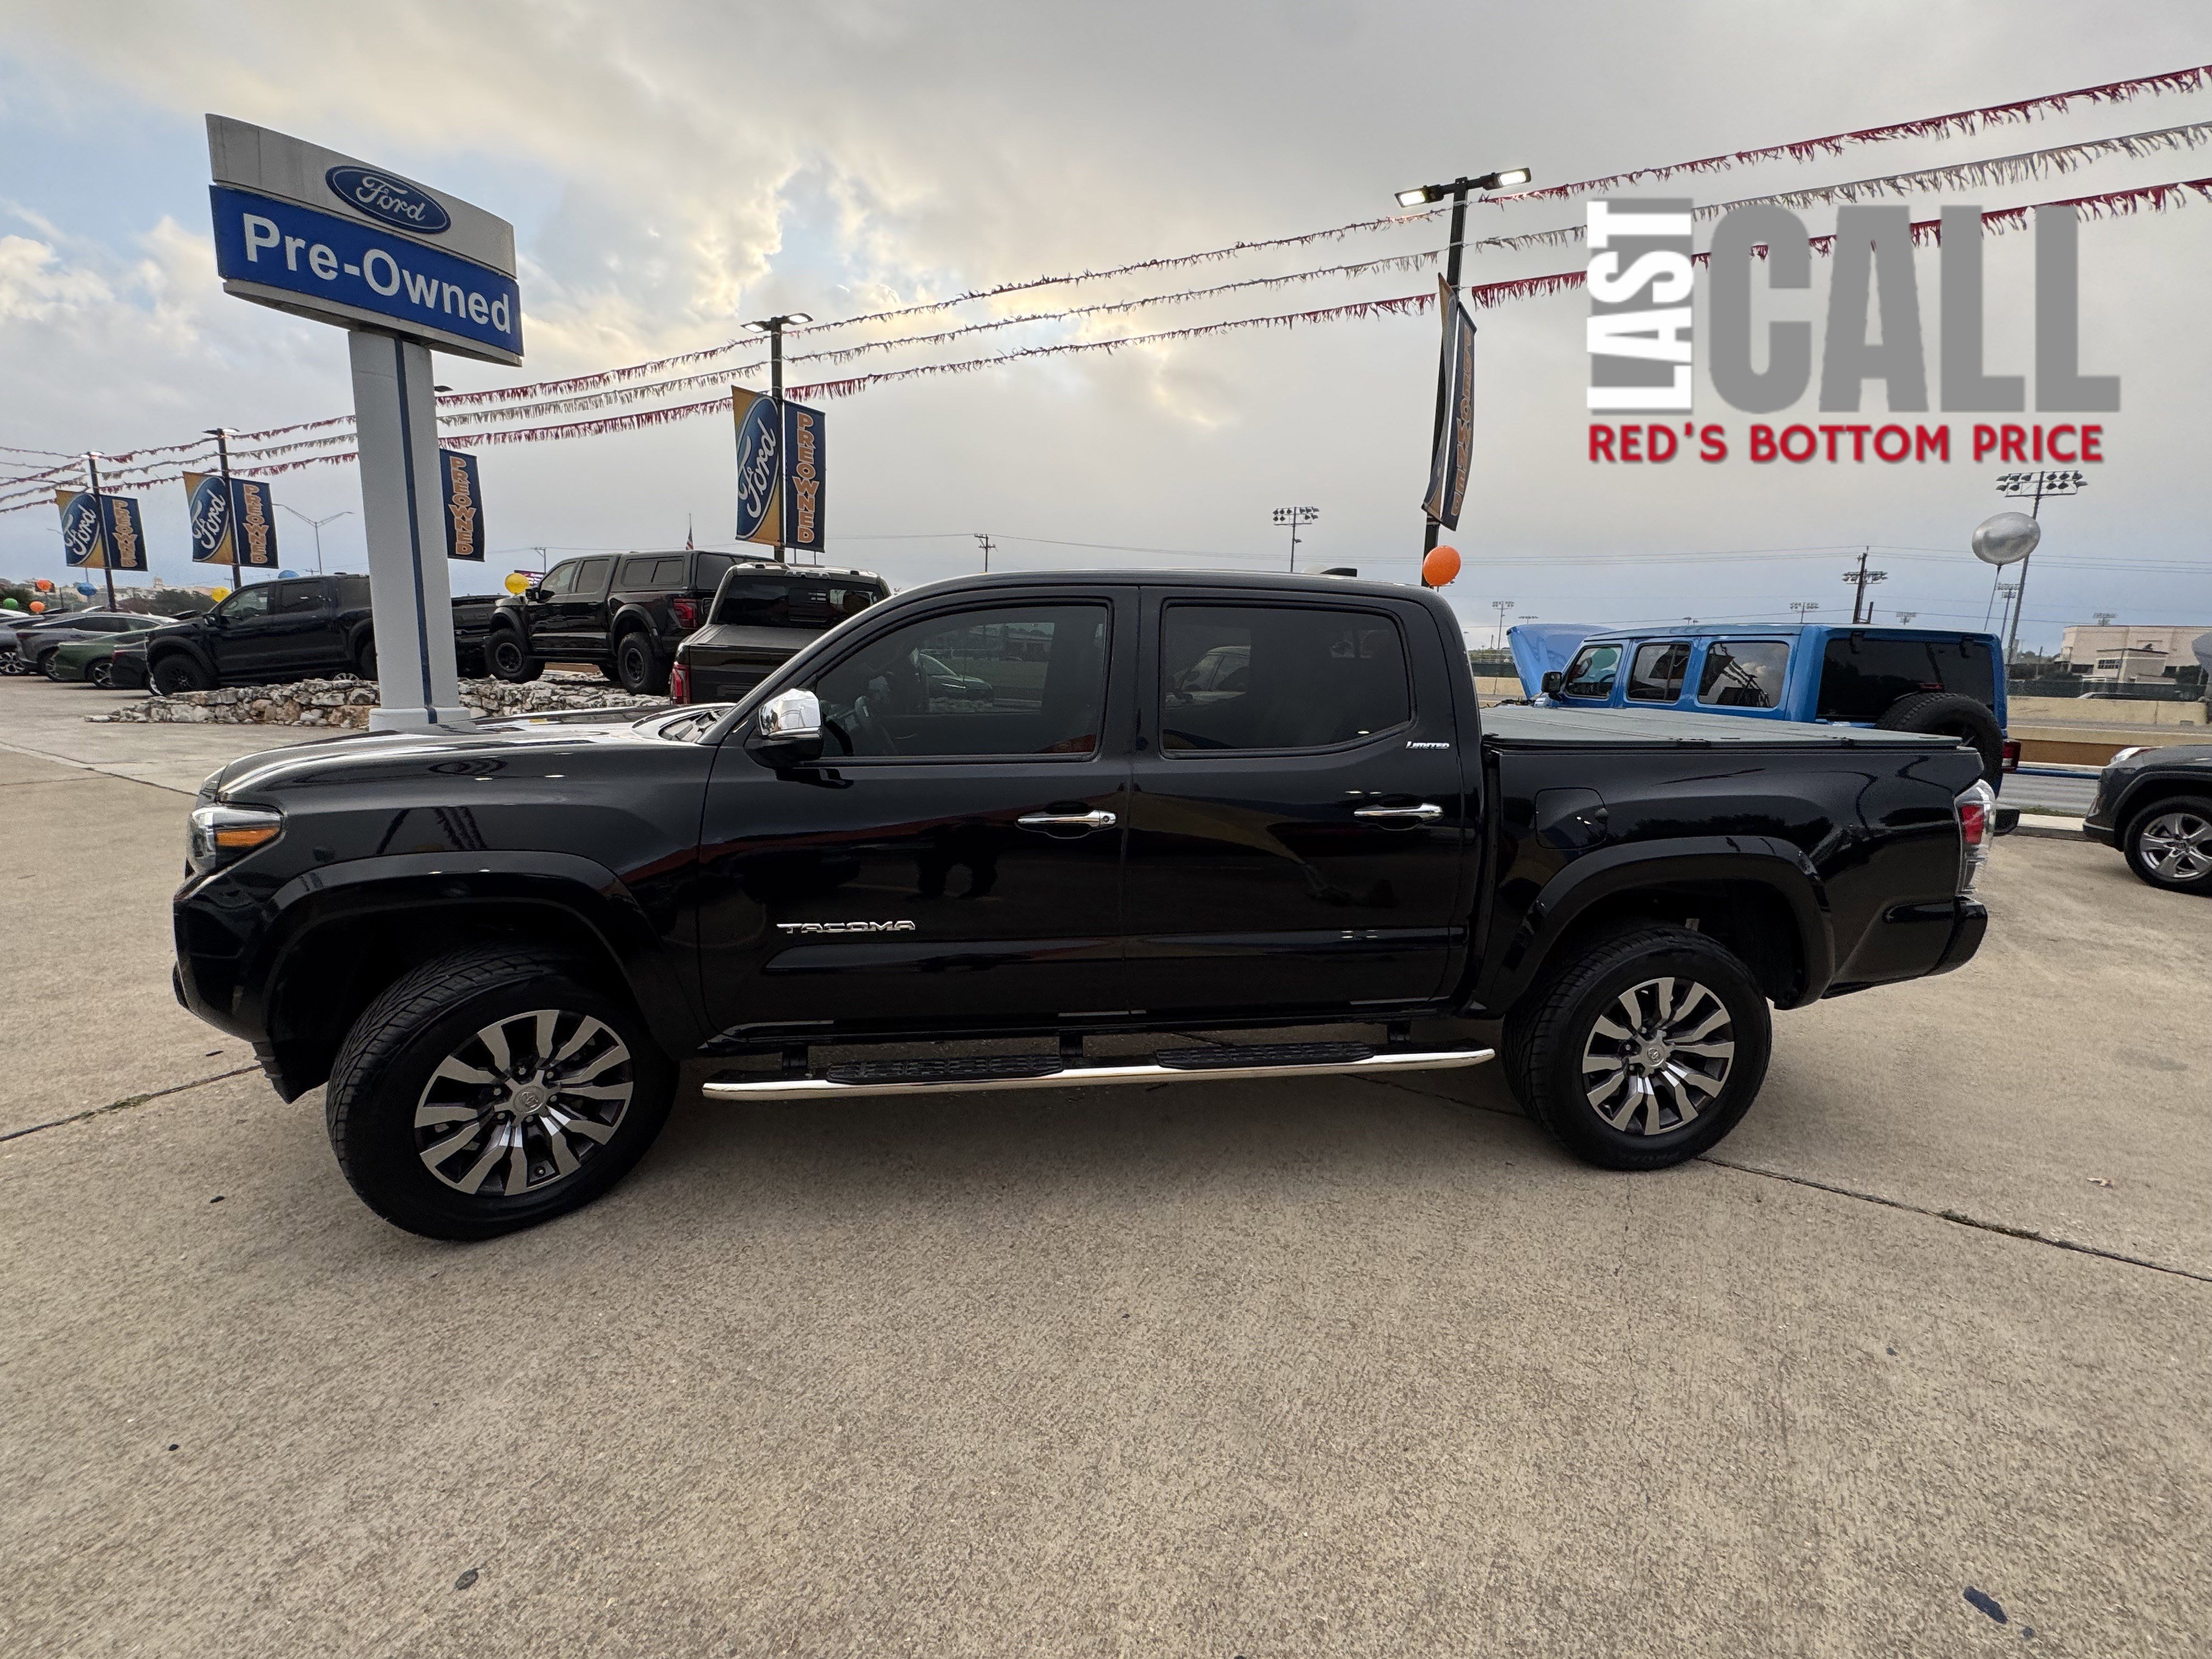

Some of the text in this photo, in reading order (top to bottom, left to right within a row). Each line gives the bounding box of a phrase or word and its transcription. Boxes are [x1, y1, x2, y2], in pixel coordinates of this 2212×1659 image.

[356, 176, 425, 222] Ford
[242, 213, 511, 334] Pre-Owned
[448, 456, 476, 555] PREOWNED
[738, 417, 776, 518] Ford
[792, 411, 820, 544] PREOWNED
[64, 504, 97, 556] Ford
[193, 489, 226, 549] Ford
[776, 921, 916, 934] TACOMA
